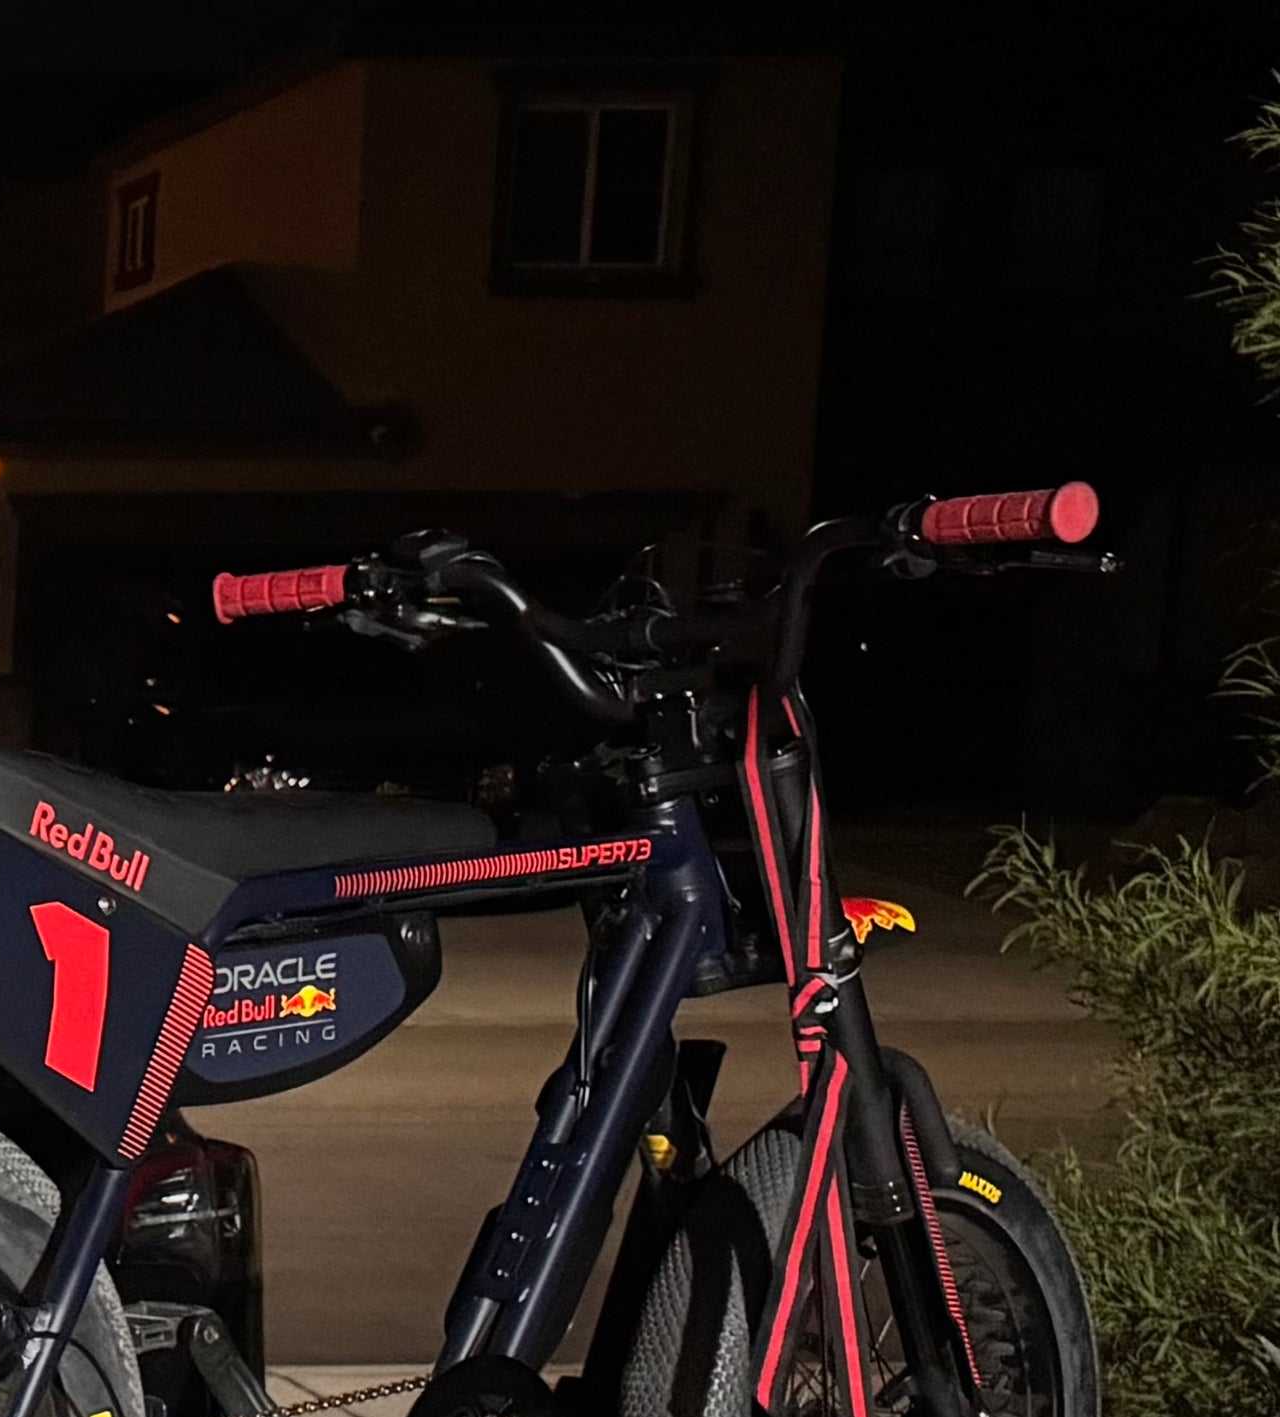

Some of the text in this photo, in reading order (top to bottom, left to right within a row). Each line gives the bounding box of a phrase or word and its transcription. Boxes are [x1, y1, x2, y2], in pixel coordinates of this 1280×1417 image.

[29, 800, 150, 891] Red Bull
[558, 838, 652, 870] SUPER73
[213, 953, 337, 994] ORACLE
[29, 901, 110, 1093] 1
[203, 995, 275, 1029] Red Bull
[202, 1025, 336, 1058] RACING
[958, 1171, 1002, 1203] MAXXIS
